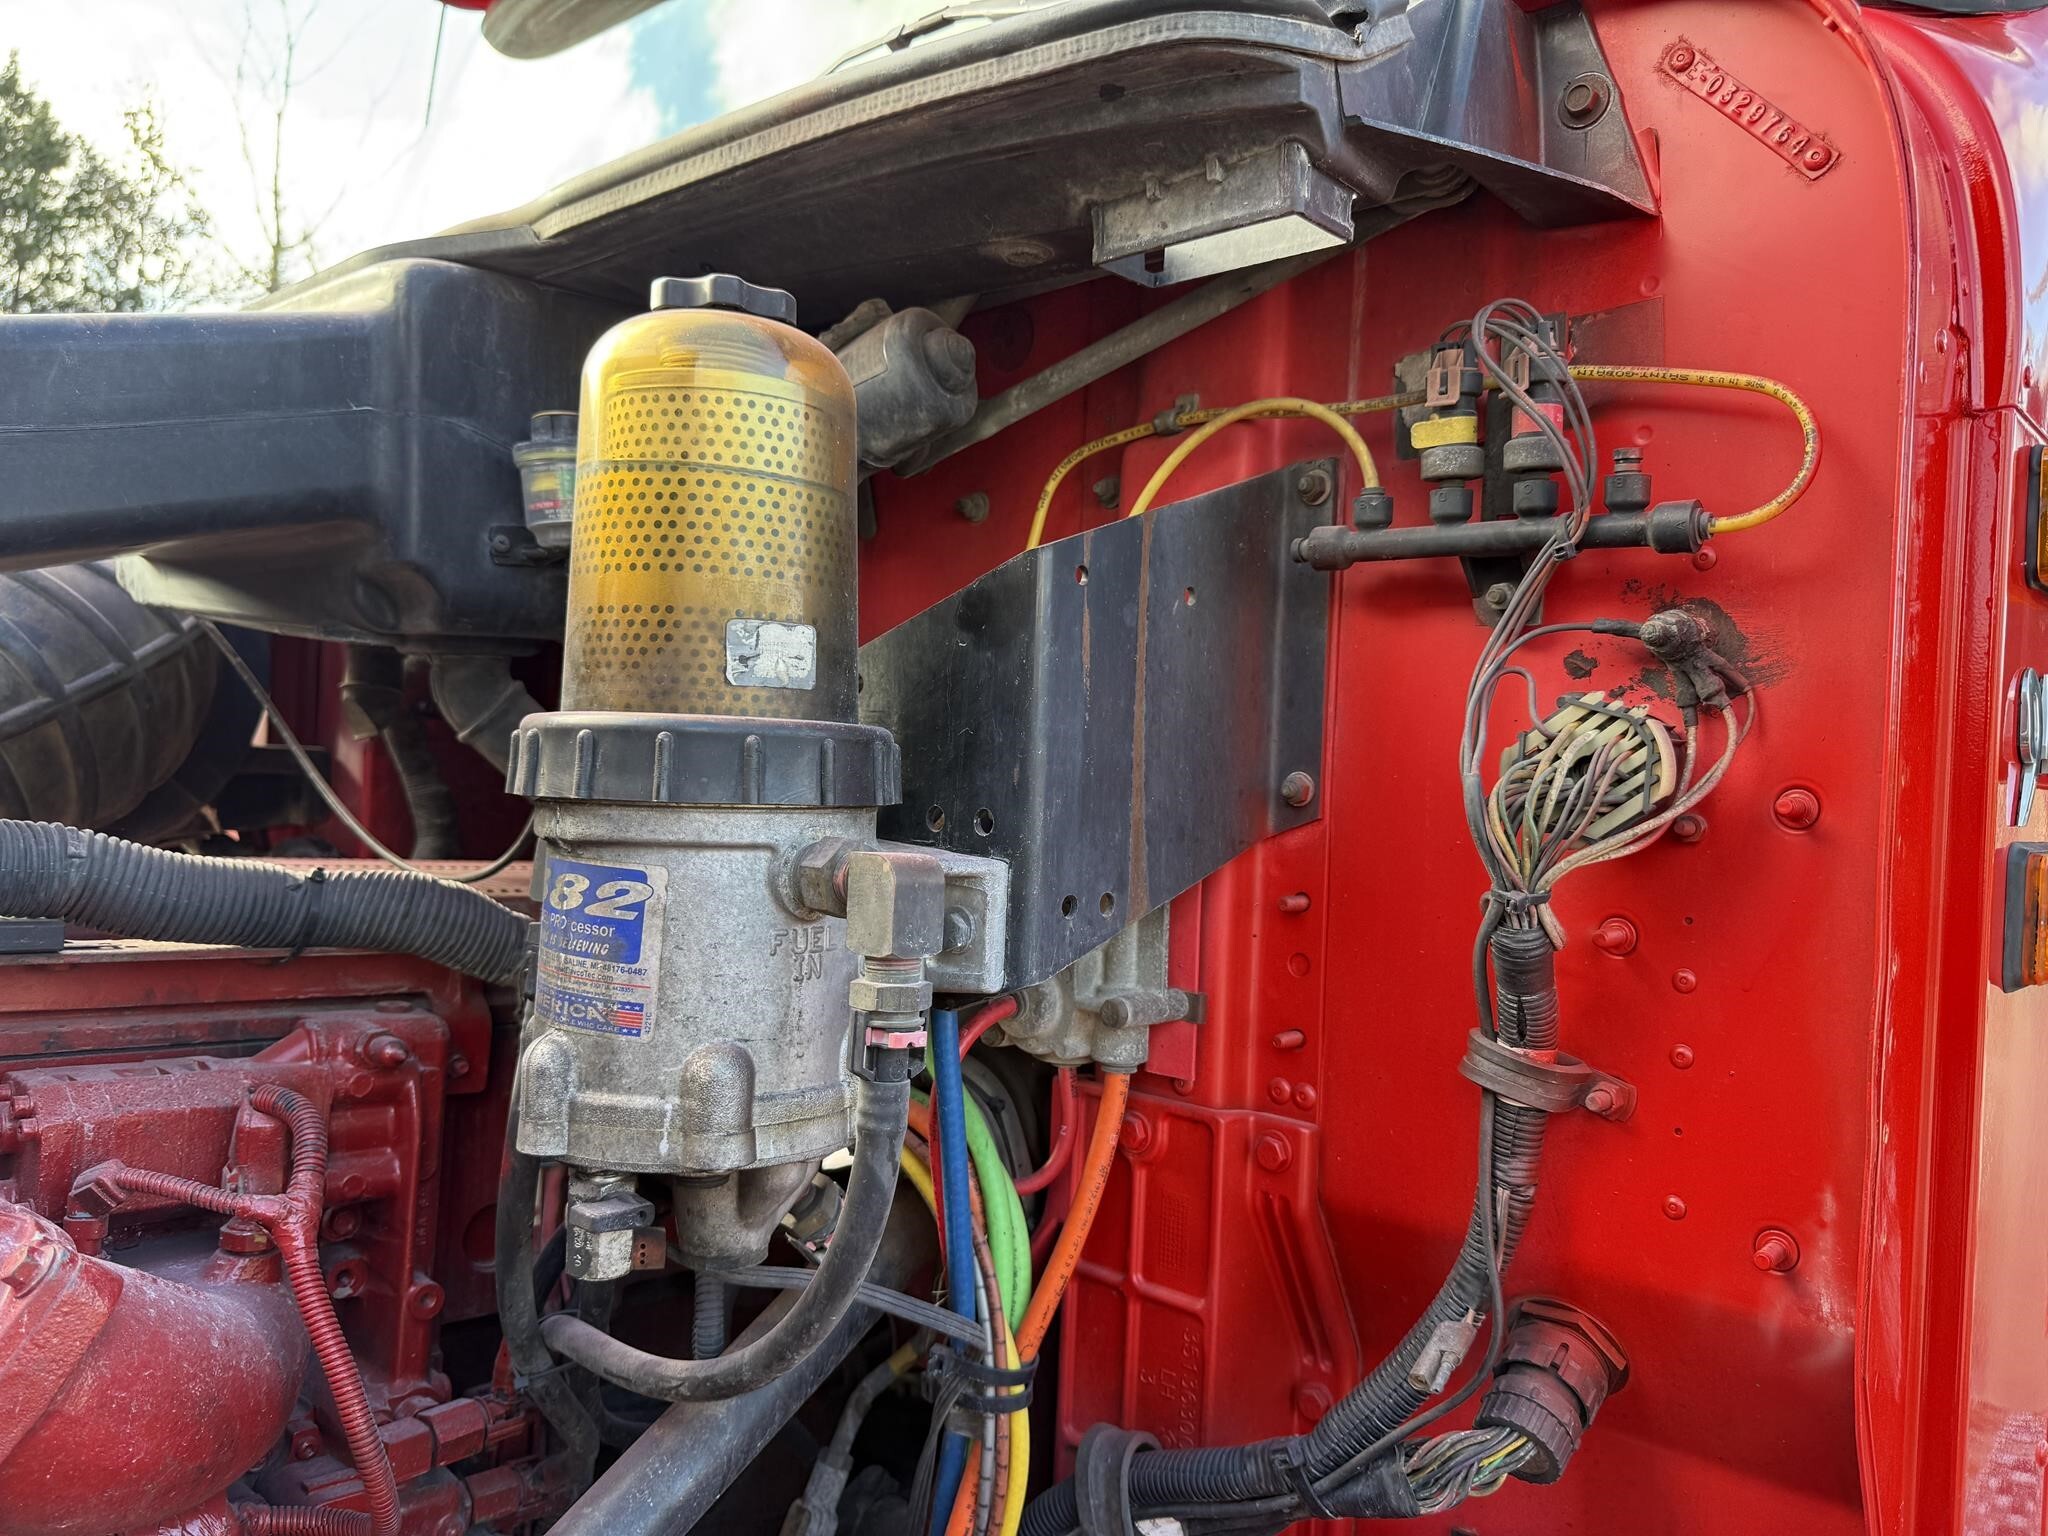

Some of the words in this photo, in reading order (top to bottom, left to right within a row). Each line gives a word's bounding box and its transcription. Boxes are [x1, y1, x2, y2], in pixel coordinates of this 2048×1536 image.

[1576, 367, 1690, 382] SAINT-GOBAIN
[1728, 377, 1739, 386] IN
[544, 869, 655, 921] 82
[769, 925, 837, 957] FUEL
[602, 962, 648, 976] 48176-0487
[792, 953, 823, 983] IN
[1159, 1368, 1177, 1401] LH
